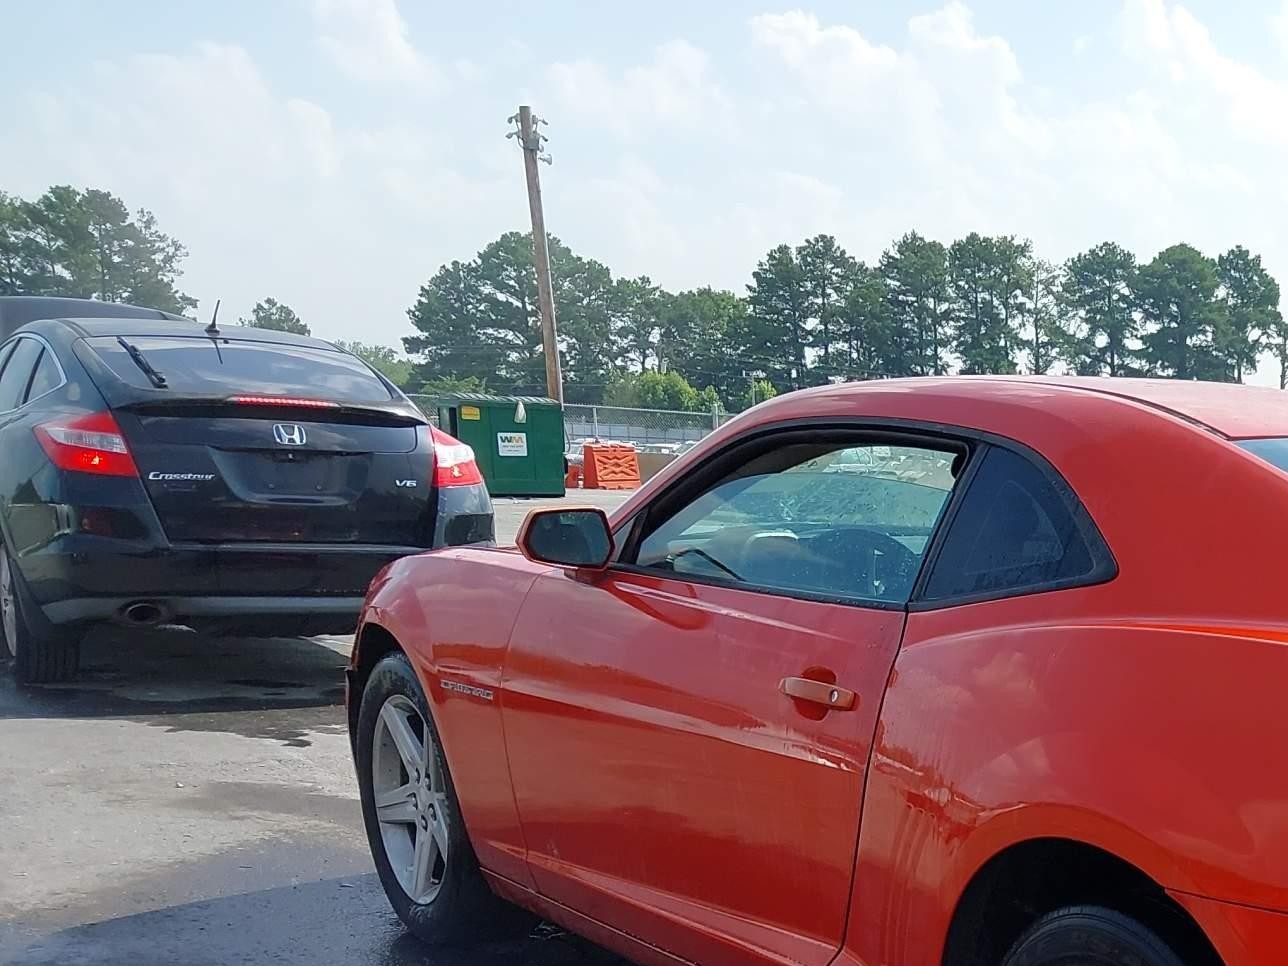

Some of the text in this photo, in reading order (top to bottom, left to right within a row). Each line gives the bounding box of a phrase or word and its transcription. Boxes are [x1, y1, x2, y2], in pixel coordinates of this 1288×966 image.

[499, 435, 525, 444] WM
[148, 471, 216, 481] Crosstour
[395, 479, 417, 488] V6
